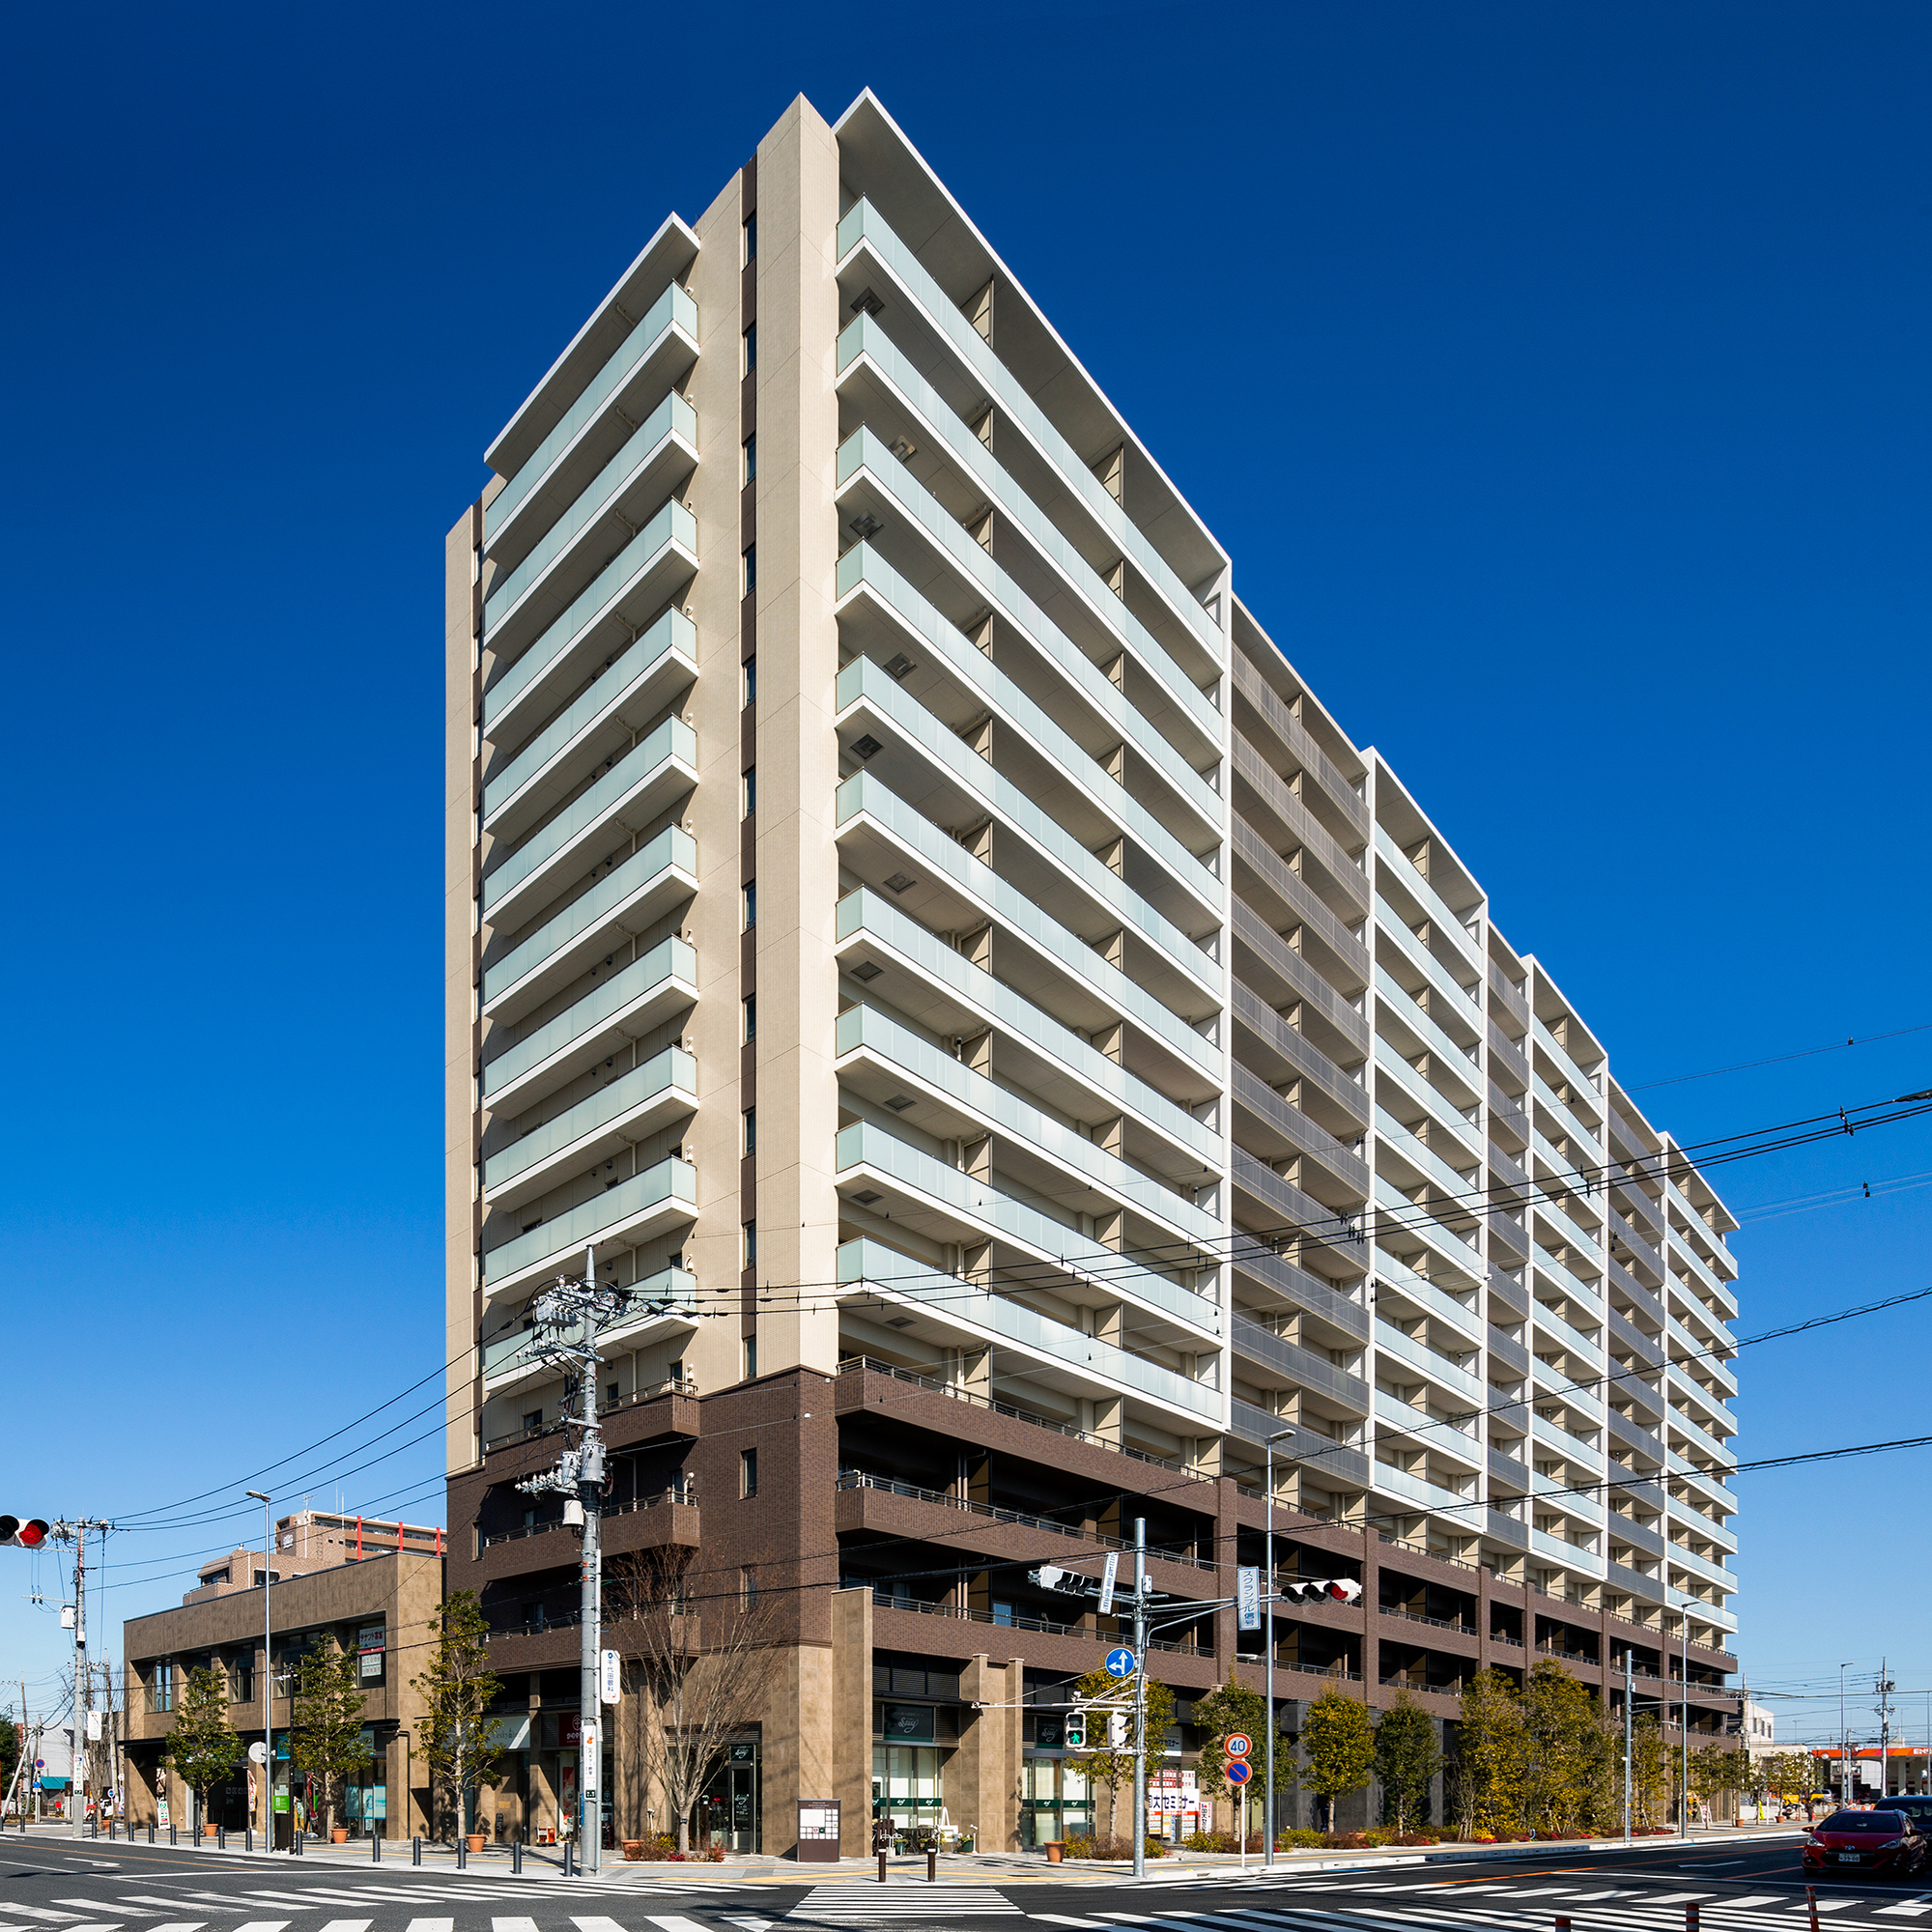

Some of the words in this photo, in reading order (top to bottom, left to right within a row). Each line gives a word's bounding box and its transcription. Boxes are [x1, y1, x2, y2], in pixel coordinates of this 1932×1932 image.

[1243, 1570, 1255, 1627] スクランブル信号
[1230, 1740, 1246, 1751] 40
